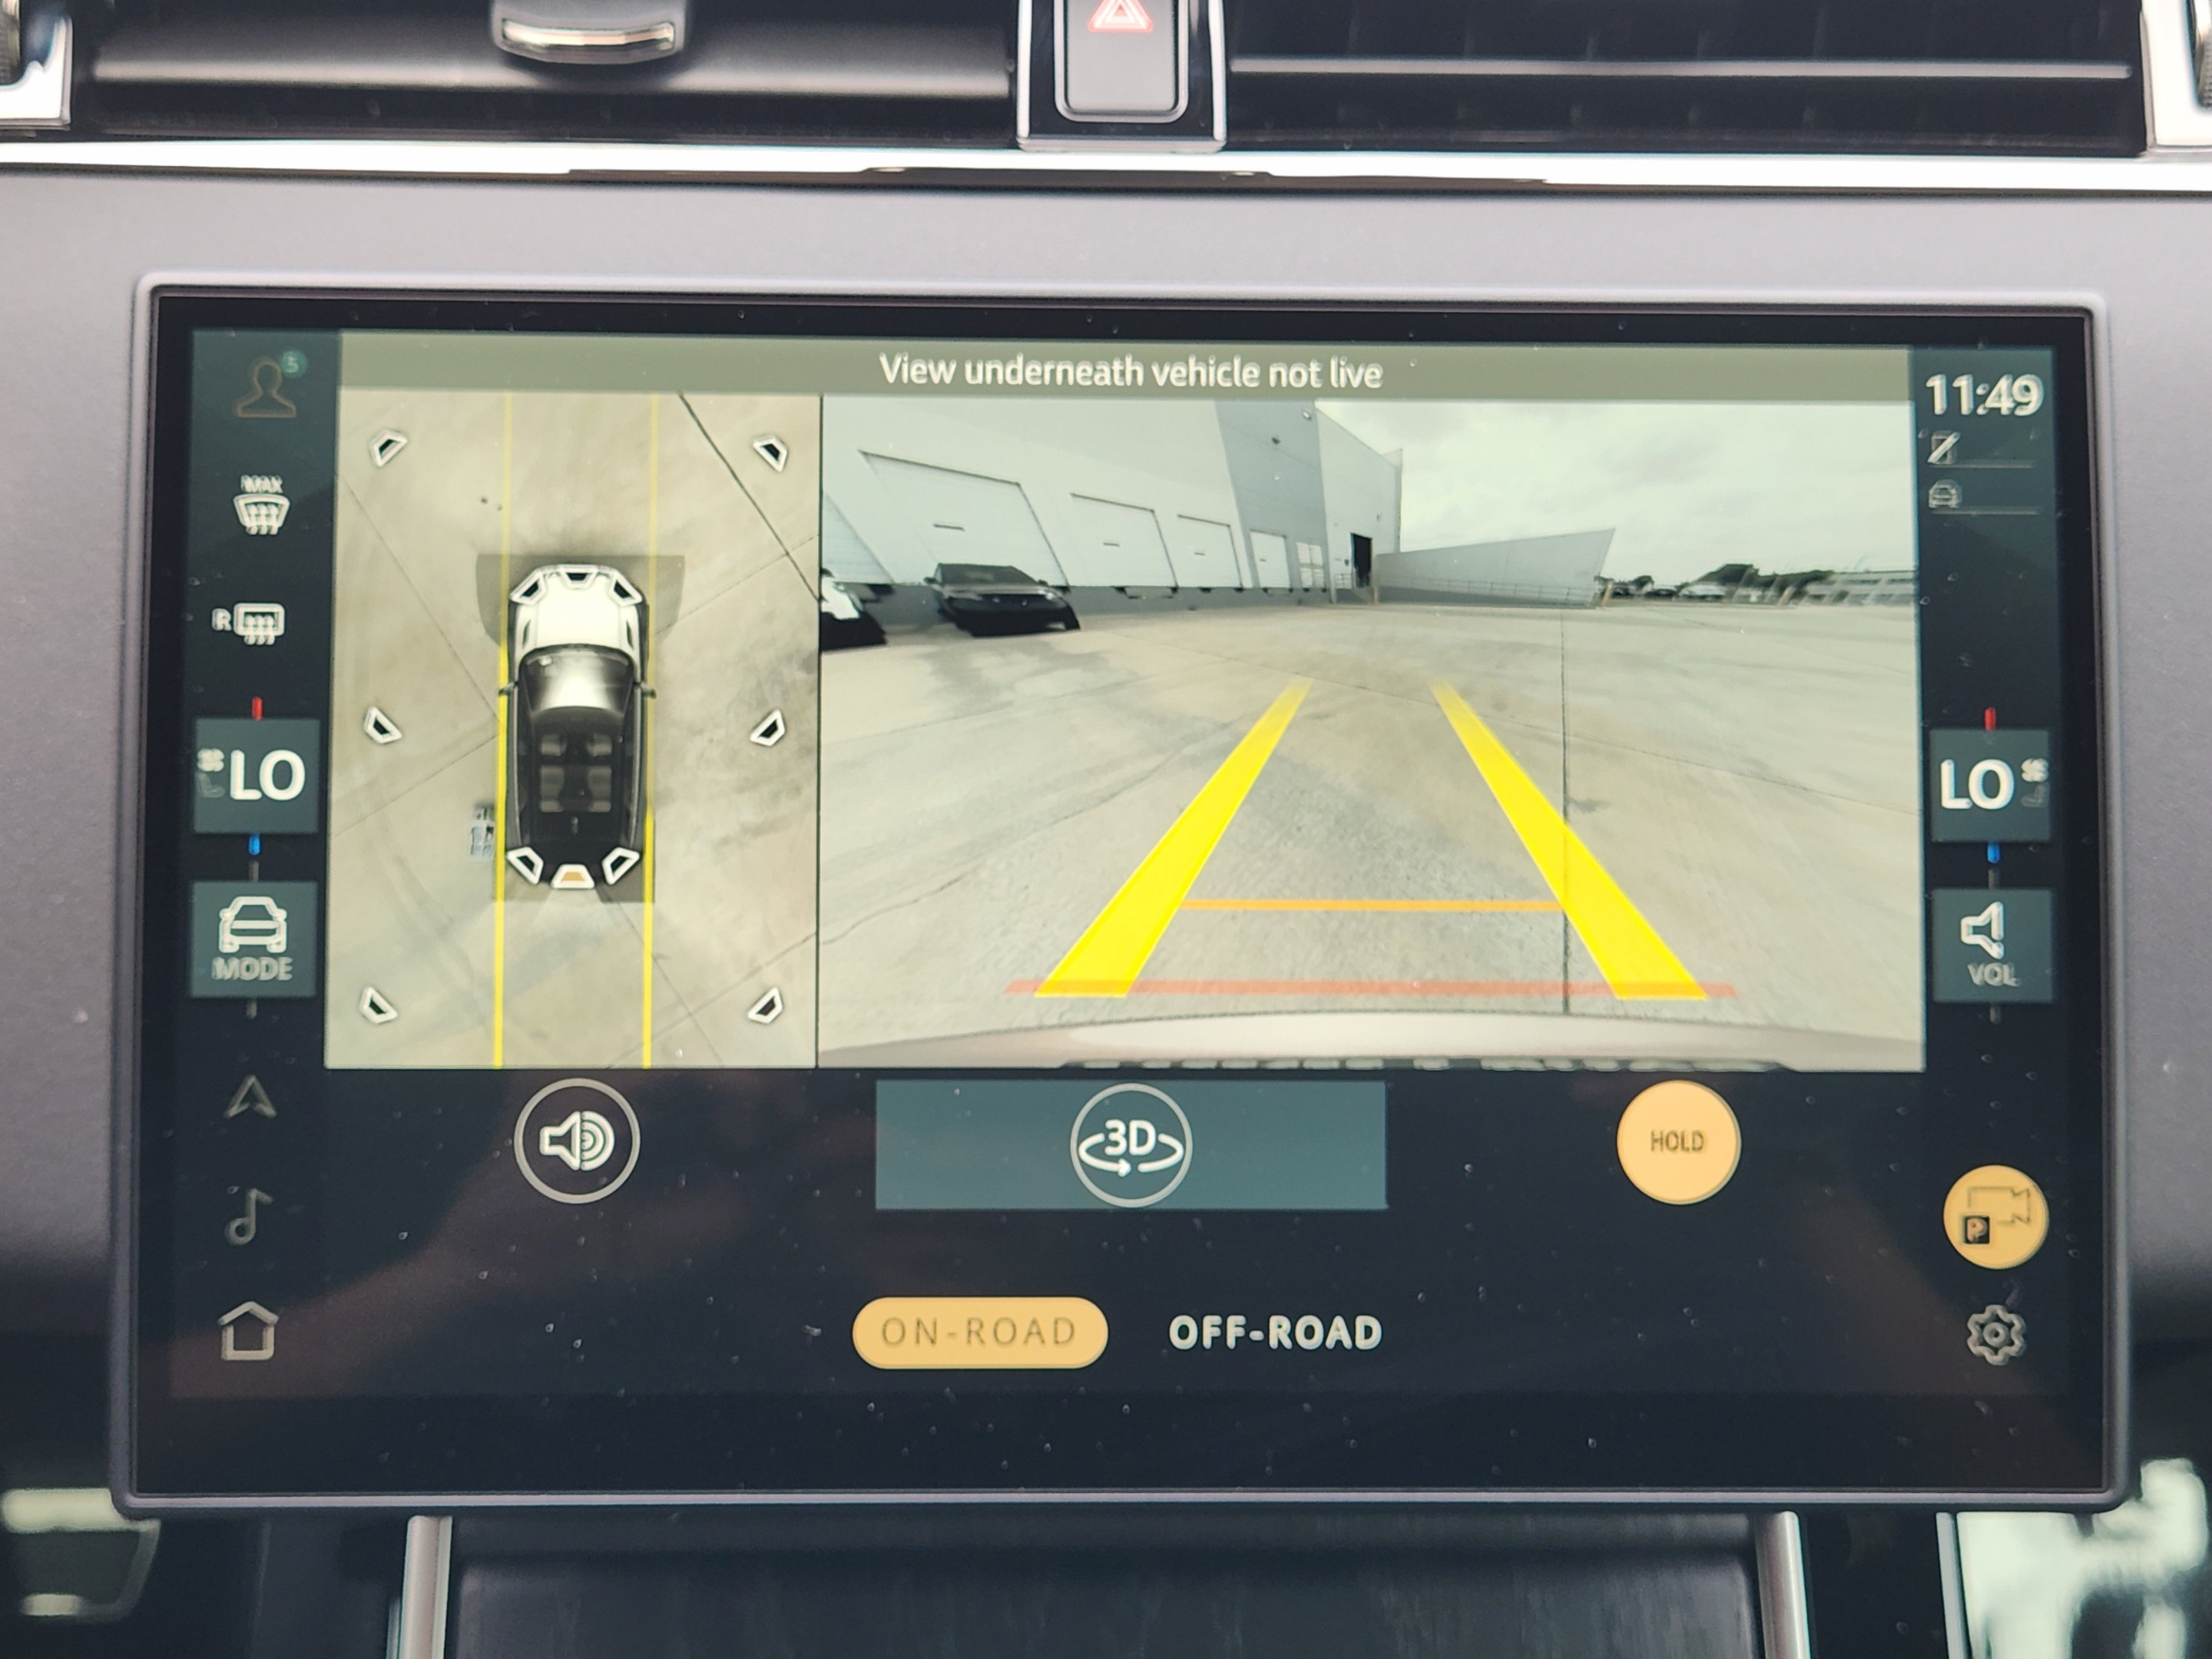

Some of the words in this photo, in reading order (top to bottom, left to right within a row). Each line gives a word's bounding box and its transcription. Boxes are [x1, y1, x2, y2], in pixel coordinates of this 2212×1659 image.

[879, 352, 956, 384] View
[965, 353, 1144, 386] underneath
[1151, 354, 1260, 387] vehicle
[1269, 358, 1323, 389] not
[1330, 355, 1383, 389] live
[1926, 373, 2044, 416] 11:49
[240, 474, 283, 493] MAX
[211, 608, 232, 631] R
[230, 749, 306, 800] LO
[1940, 758, 2015, 810] LO
[211, 956, 293, 981] MODE
[1967, 962, 2022, 987] VOL
[1103, 1118, 1157, 1157] 3D
[1650, 1129, 1705, 1152] HOLD
[882, 1316, 1075, 1346] ON-ROAD
[1168, 1314, 1383, 1351] OFF-ROAD
